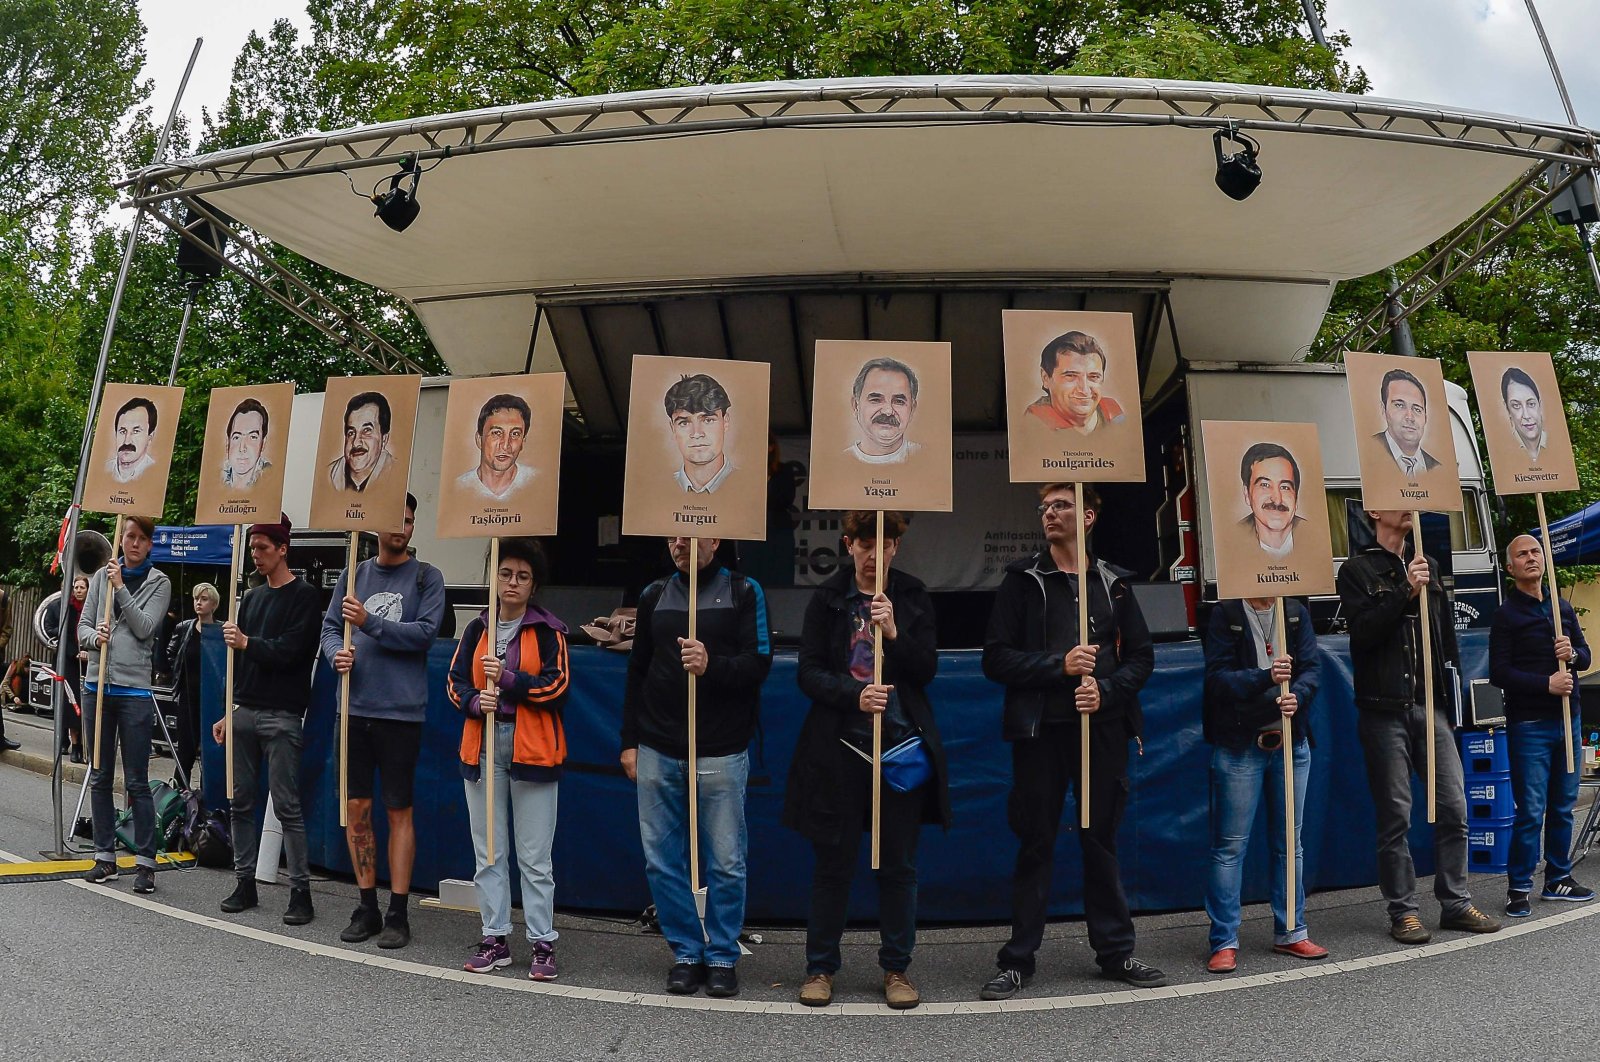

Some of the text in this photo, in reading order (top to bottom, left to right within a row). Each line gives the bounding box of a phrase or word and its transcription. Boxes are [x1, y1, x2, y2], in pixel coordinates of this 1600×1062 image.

[1042, 458, 1115, 470] Boulgarides
[1514, 473, 1559, 482] Kiesewetter
[864, 486, 899, 498] Yaşar
[1400, 489, 1429, 500] Yozgat
[109, 495, 135, 505] Şimşek
[219, 504, 257, 515] Özüdoğru
[345, 510, 366, 520] Kılıç
[470, 513, 521, 525] Taşköprü
[672, 511, 718, 526] Turgut
[1256, 571, 1300, 584] Kubaşık
